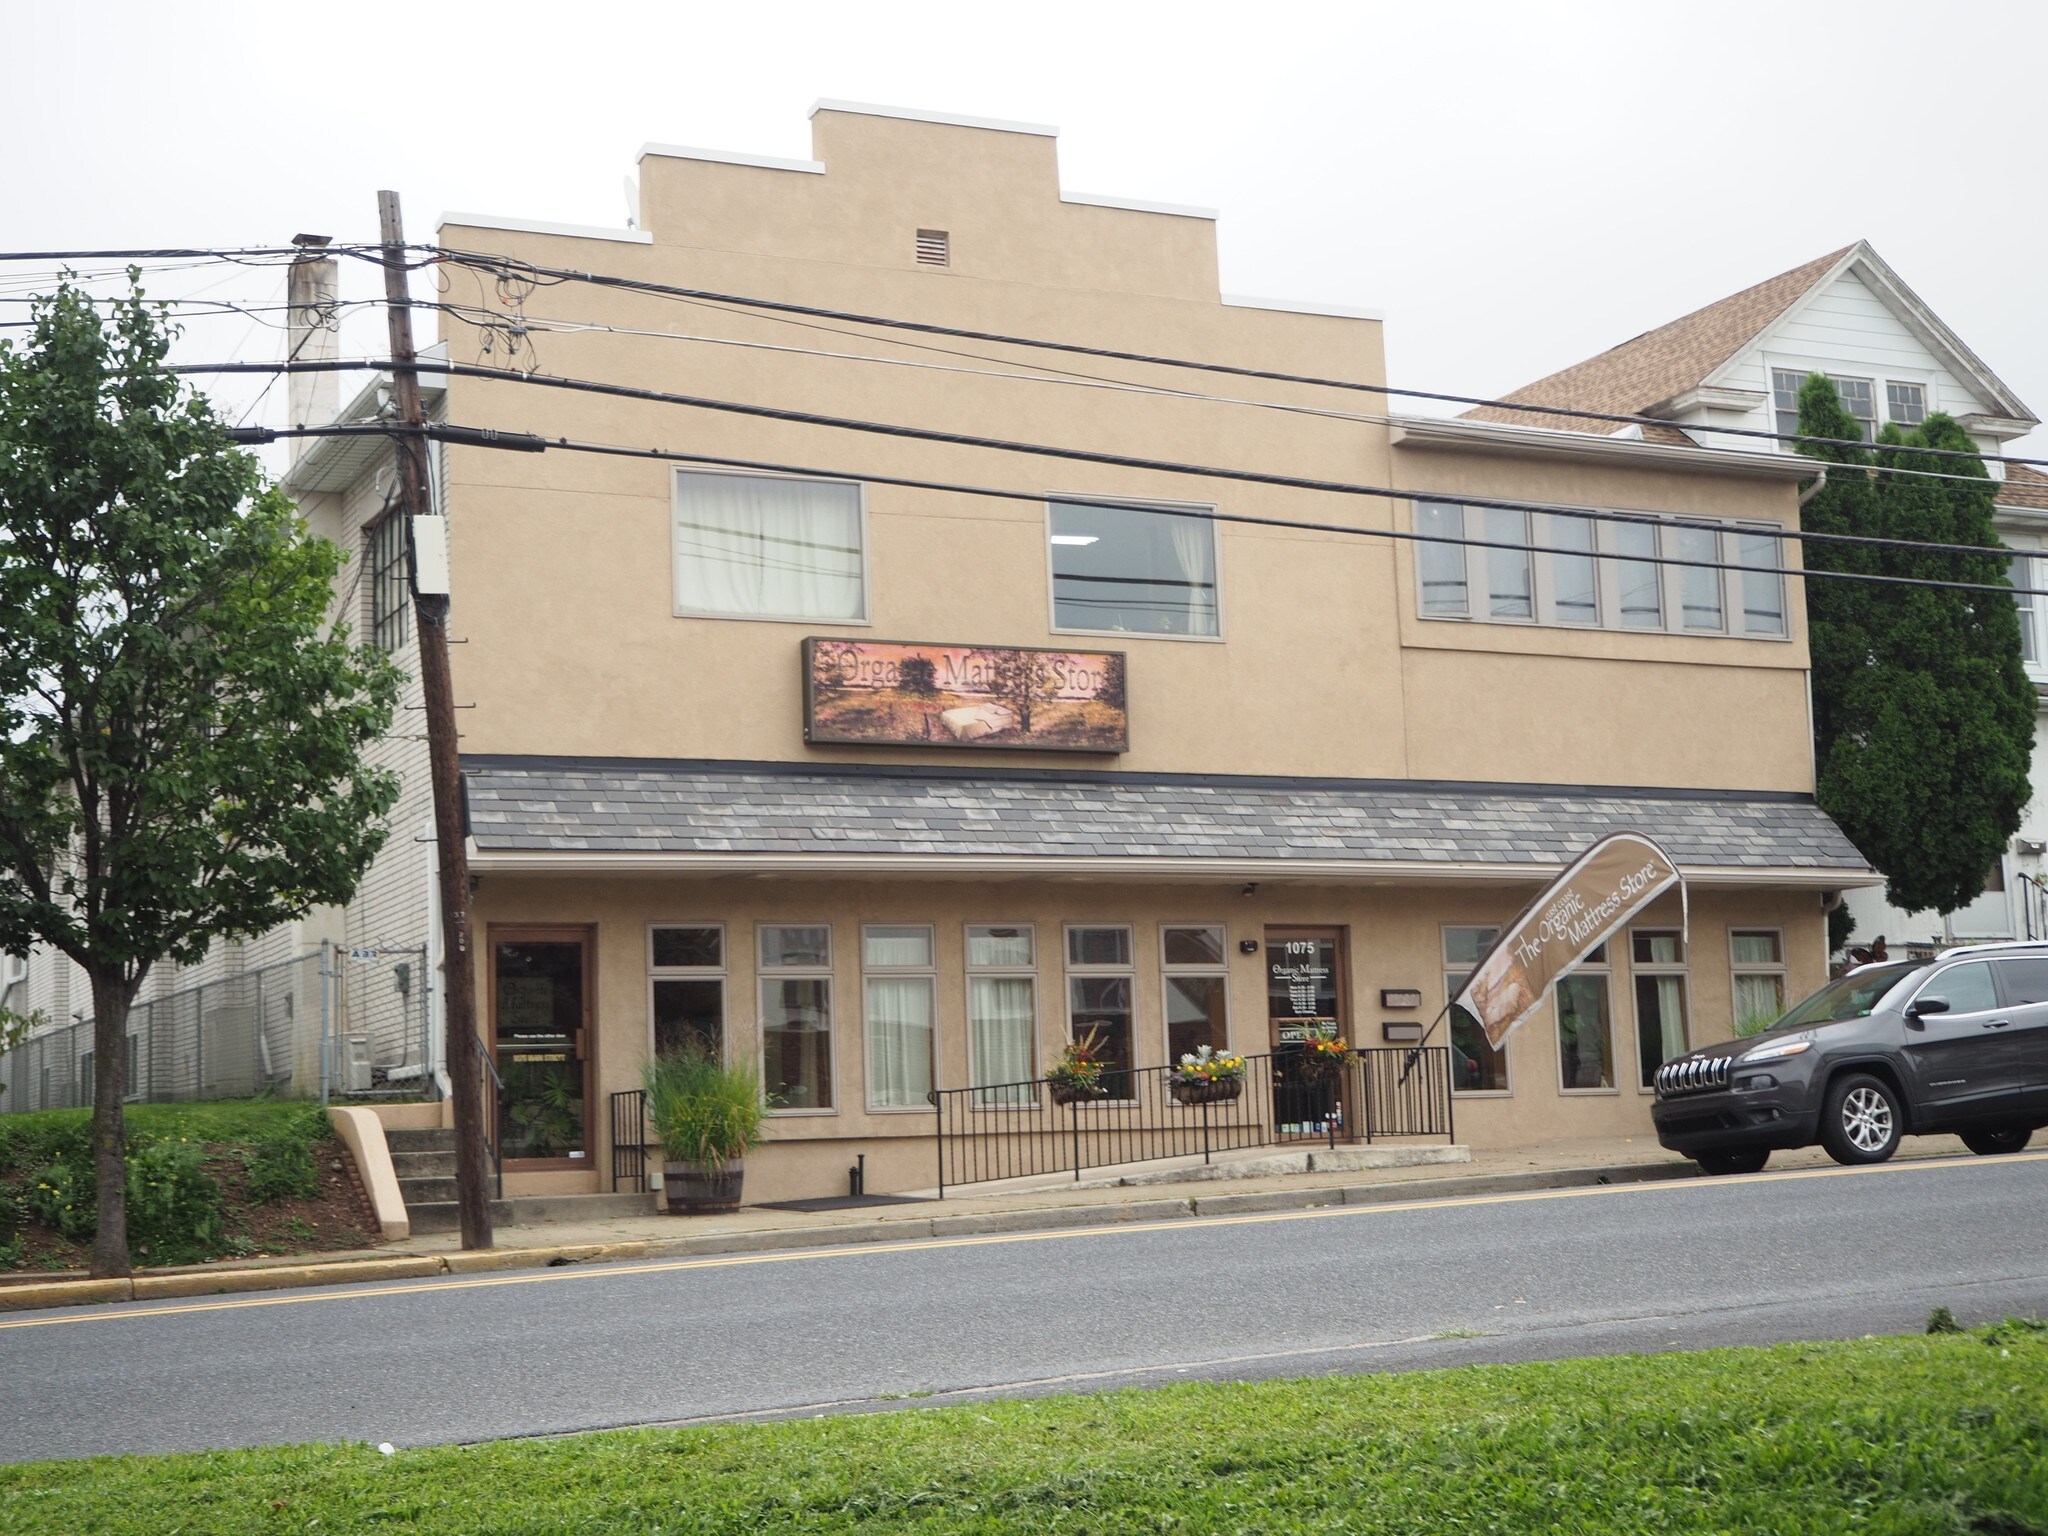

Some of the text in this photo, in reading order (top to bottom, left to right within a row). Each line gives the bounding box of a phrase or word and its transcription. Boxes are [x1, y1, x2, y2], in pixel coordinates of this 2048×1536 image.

[839, 649, 922, 692] Orga
[1052, 658, 1109, 692] Stor
[1567, 863, 1658, 946] Mattress Store
[1285, 942, 1315, 954] 1075
[1514, 893, 1585, 968] The Organic
[1281, 1030, 1306, 1040] OPE
